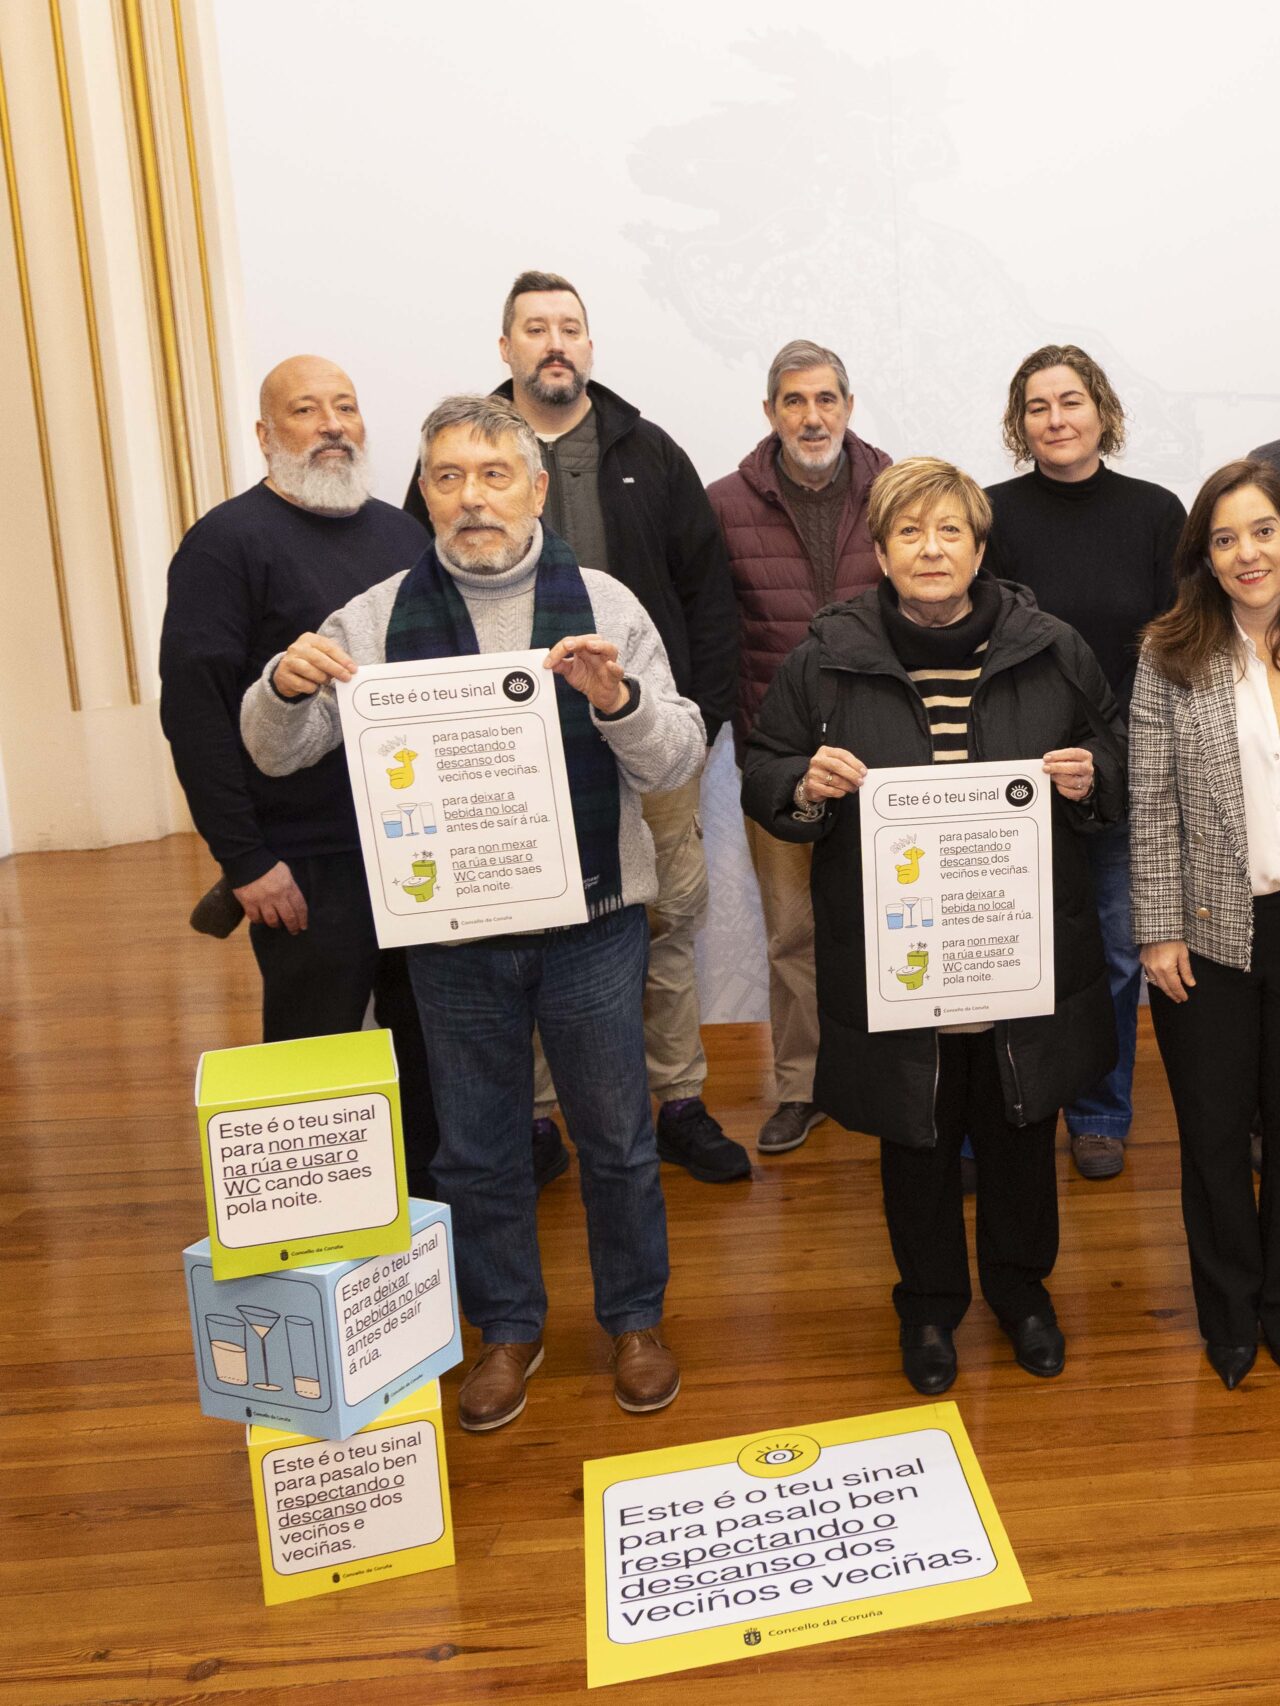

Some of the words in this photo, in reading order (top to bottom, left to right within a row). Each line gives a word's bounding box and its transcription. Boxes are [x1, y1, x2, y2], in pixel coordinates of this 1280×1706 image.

[370, 693, 404, 707] Este
[408, 688, 417, 703] é
[421, 691, 430, 701] o
[434, 688, 458, 700] teu
[461, 681, 495, 697] sinal
[432, 732, 459, 744] para
[461, 726, 499, 740] pasalo
[501, 724, 522, 734] ben
[435, 739, 506, 755] respectando
[508, 739, 516, 747] o
[888, 794, 918, 806] Este
[921, 791, 930, 804] é
[933, 794, 941, 803] o
[944, 792, 965, 803] teu
[968, 787, 999, 801] sinal
[940, 892, 963, 903] para
[965, 889, 995, 899] deixar
[940, 902, 975, 913] bebida
[977, 902, 990, 910] no
[992, 898, 1015, 909] local
[941, 916, 970, 925] antes
[971, 914, 984, 923] de
[986, 911, 1005, 922] saír
[1006, 910, 1013, 920] á
[1014, 909, 1032, 919] rúa.
[219, 1122, 262, 1139] Este
[267, 1115, 278, 1132] é
[283, 1118, 294, 1130] o
[299, 1113, 328, 1128] teu
[332, 1103, 375, 1123] sinal
[221, 1142, 264, 1162] para
[268, 1136, 303, 1152] non
[308, 1127, 366, 1146] mexar
[222, 1163, 247, 1177] na
[250, 1155, 281, 1173] rúa
[285, 1156, 297, 1168] e
[302, 1149, 343, 1166] usar
[346, 1147, 357, 1160] o
[223, 1177, 260, 1196] WC
[264, 1170, 323, 1190] cando
[327, 1164, 371, 1181] saes
[226, 1197, 266, 1219] pola
[271, 1190, 321, 1209] noite.
[342, 1276, 370, 1300] Este
[371, 1266, 379, 1283] é
[382, 1265, 389, 1277] o
[391, 1253, 409, 1272] teu
[411, 1233, 438, 1260] sinal
[343, 1295, 371, 1323] para
[373, 1272, 409, 1302] deixar
[345, 1324, 353, 1337] a
[355, 1299, 396, 1331] bebida
[398, 1289, 412, 1305] no
[414, 1268, 440, 1296] local
[347, 1327, 380, 1356] antes
[382, 1316, 398, 1334] de
[400, 1299, 421, 1323] saír
[348, 1357, 356, 1374] á
[358, 1348, 381, 1368] rúa.
[273, 1456, 314, 1474] Este
[318, 1449, 329, 1465] é
[333, 1450, 344, 1462] o
[348, 1444, 376, 1459] teu
[380, 1431, 422, 1452] sinal
[274, 1474, 315, 1495] para
[319, 1460, 379, 1486] pasalo
[383, 1453, 416, 1470] ben
[276, 1475, 389, 1509] respectando
[392, 1473, 404, 1485] o
[619, 1499, 704, 1525] Este
[713, 1489, 735, 1509] é
[744, 1488, 766, 1503] o
[777, 1477, 832, 1498] teu
[842, 1458, 924, 1486] sinal
[277, 1499, 366, 1527] descanso
[369, 1492, 402, 1508] dos
[619, 1522, 706, 1553] para
[715, 1498, 841, 1536] pasalo
[850, 1485, 917, 1508] ben
[280, 1521, 349, 1545] veciños
[353, 1518, 364, 1529] e
[620, 1518, 863, 1574] respectando
[873, 1513, 895, 1528] o
[281, 1538, 355, 1562] veciñas.
[621, 1551, 815, 1599] descanso
[824, 1536, 894, 1561] dos
[621, 1583, 779, 1626] veciños
[789, 1577, 812, 1594] e
[822, 1548, 979, 1588] veciñas.
[768, 1622, 819, 1636] Concello
[822, 1618, 837, 1626] da
[840, 1610, 883, 1622] Coruña
